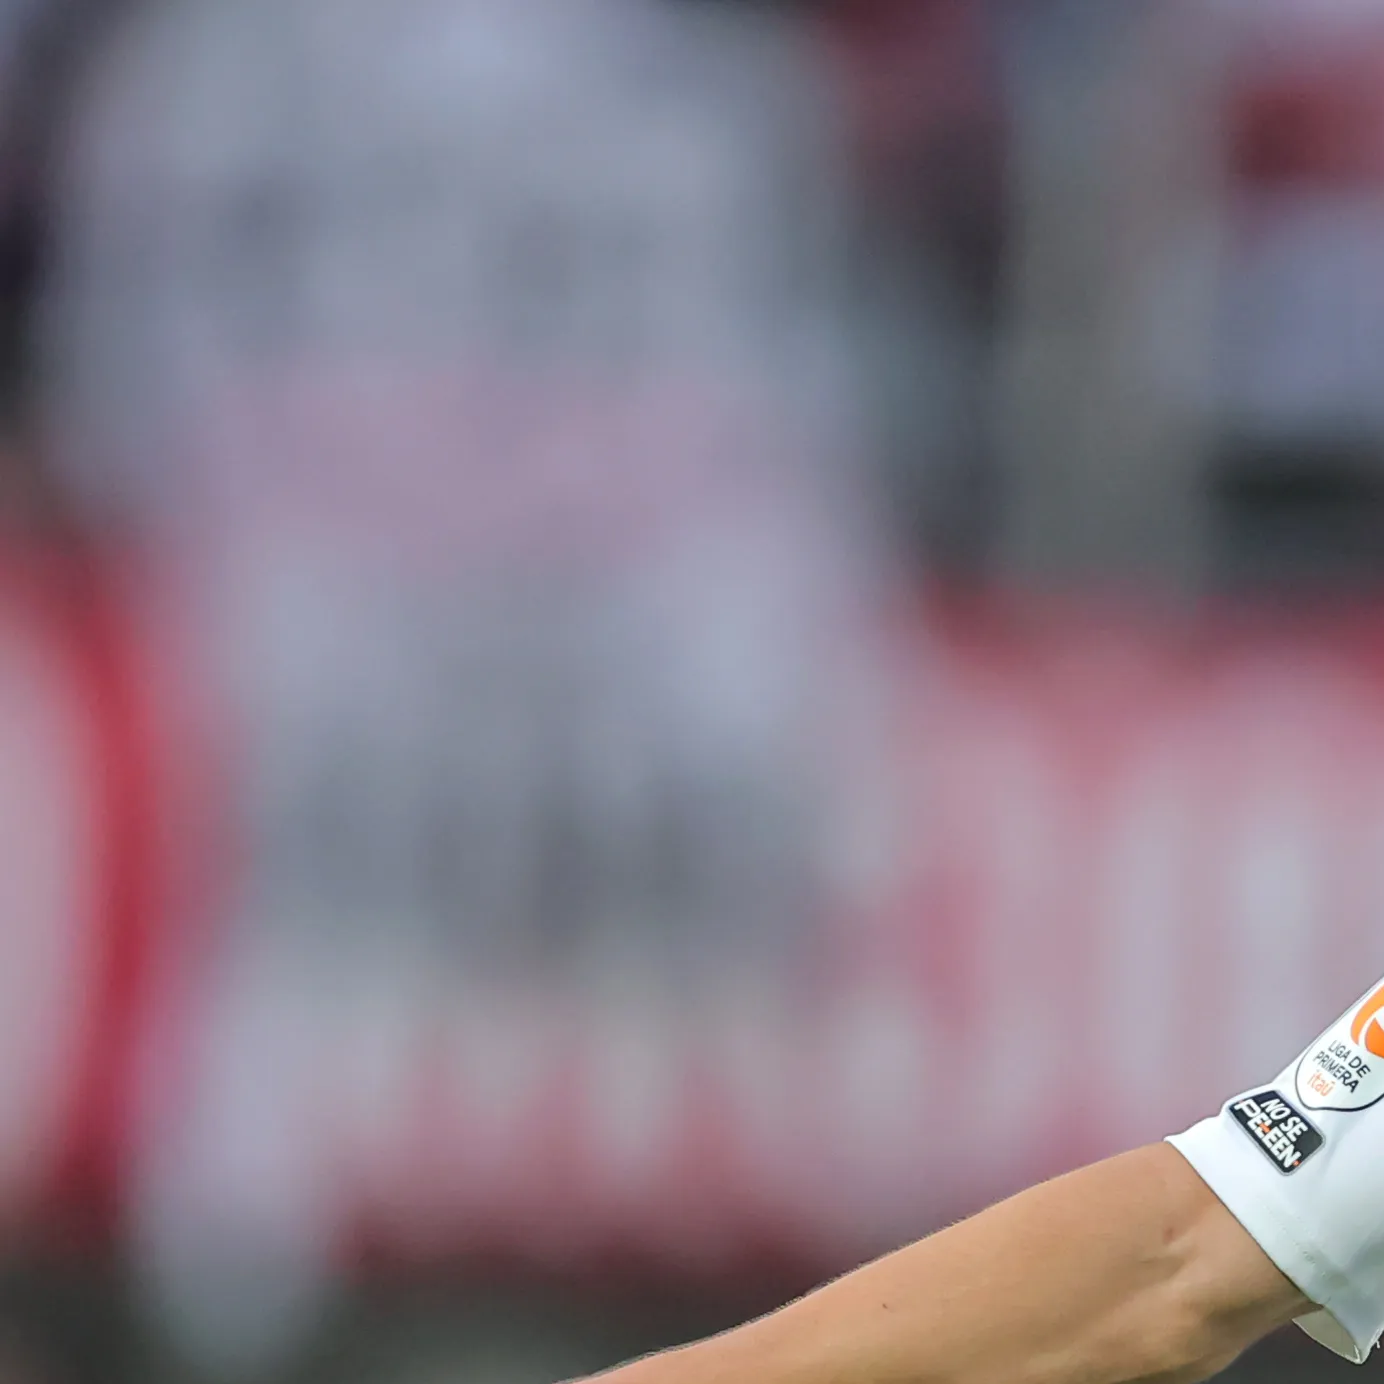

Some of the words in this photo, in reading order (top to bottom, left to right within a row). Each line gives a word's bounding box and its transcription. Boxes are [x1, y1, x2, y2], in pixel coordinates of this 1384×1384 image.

[1313, 1051, 1359, 1093] PRIMERA
[1328, 1040, 1351, 1061] LIGA
[1348, 1056, 1371, 1078] DE
[1260, 1099, 1291, 1120] NO
[1279, 1116, 1308, 1142] SE
